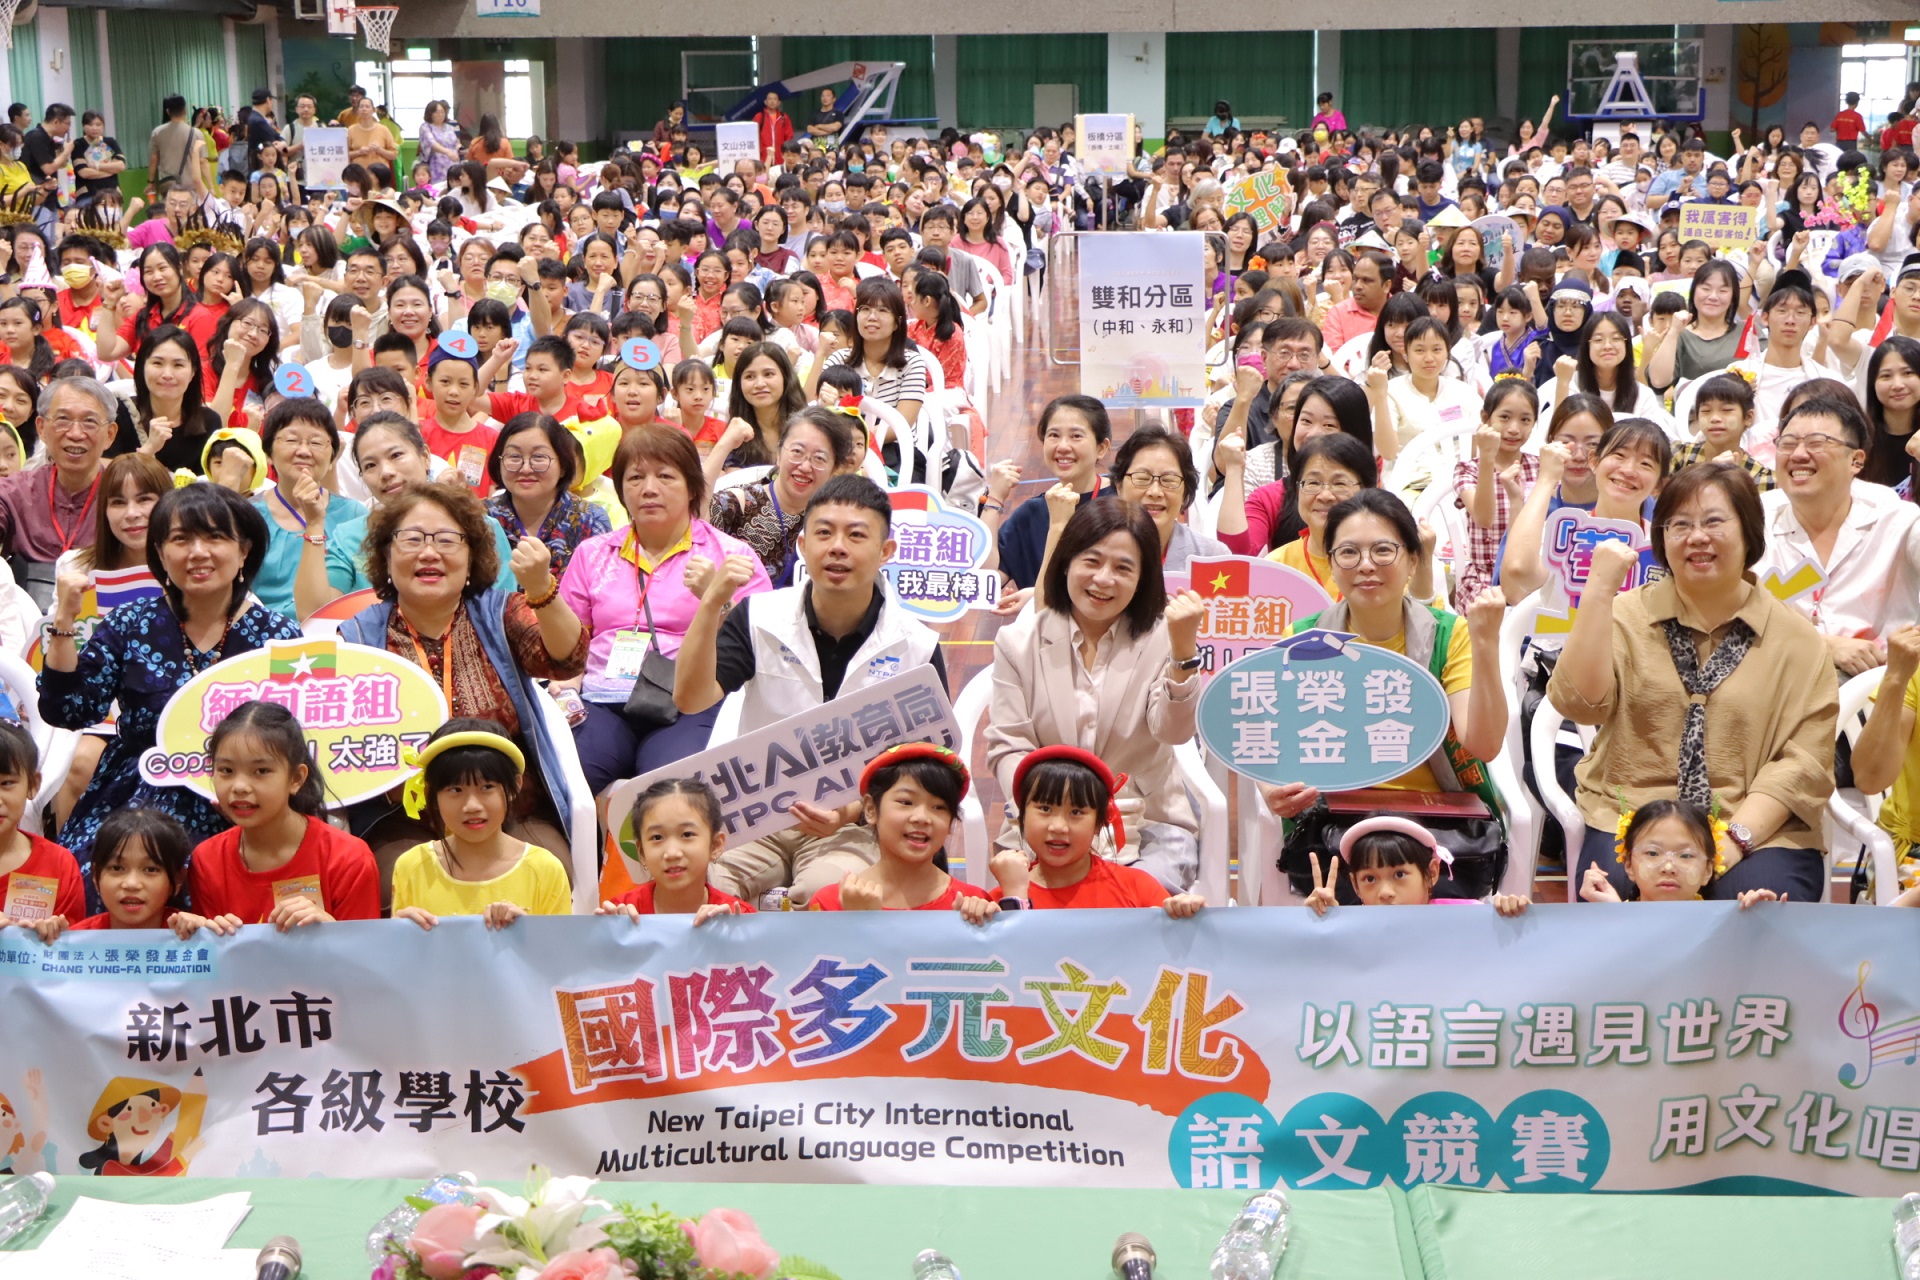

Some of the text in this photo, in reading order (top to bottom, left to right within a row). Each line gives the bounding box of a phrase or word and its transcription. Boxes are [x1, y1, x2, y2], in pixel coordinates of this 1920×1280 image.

[1087, 132, 1123, 141] 板橋分區
[1685, 209, 1748, 226] 我厲害得
[1091, 284, 1194, 310] 雙和分區
[448, 338, 467, 353] 4
[632, 345, 650, 363] 5
[286, 371, 305, 393] 2
[890, 526, 970, 565] 語組
[1230, 669, 1413, 716] 張榮發
[1231, 719, 1414, 765] 基金會
[813, 767, 855, 802] AI
[42, 962, 212, 974] CHANG YUNG-FA FOUNDATION
[126, 991, 333, 1063] 新北市
[554, 956, 1245, 1091] 國際多元文化
[1299, 995, 1791, 1067] 以語言遇見世界
[251, 1068, 526, 1136] 各級學校
[647, 1101, 1074, 1134] New Taipei City International
[1652, 1085, 1920, 1170] 用文化唱
[595, 1135, 1125, 1175] Multicultural Language Competition
[1188, 1109, 1590, 1189] 語文競賽
